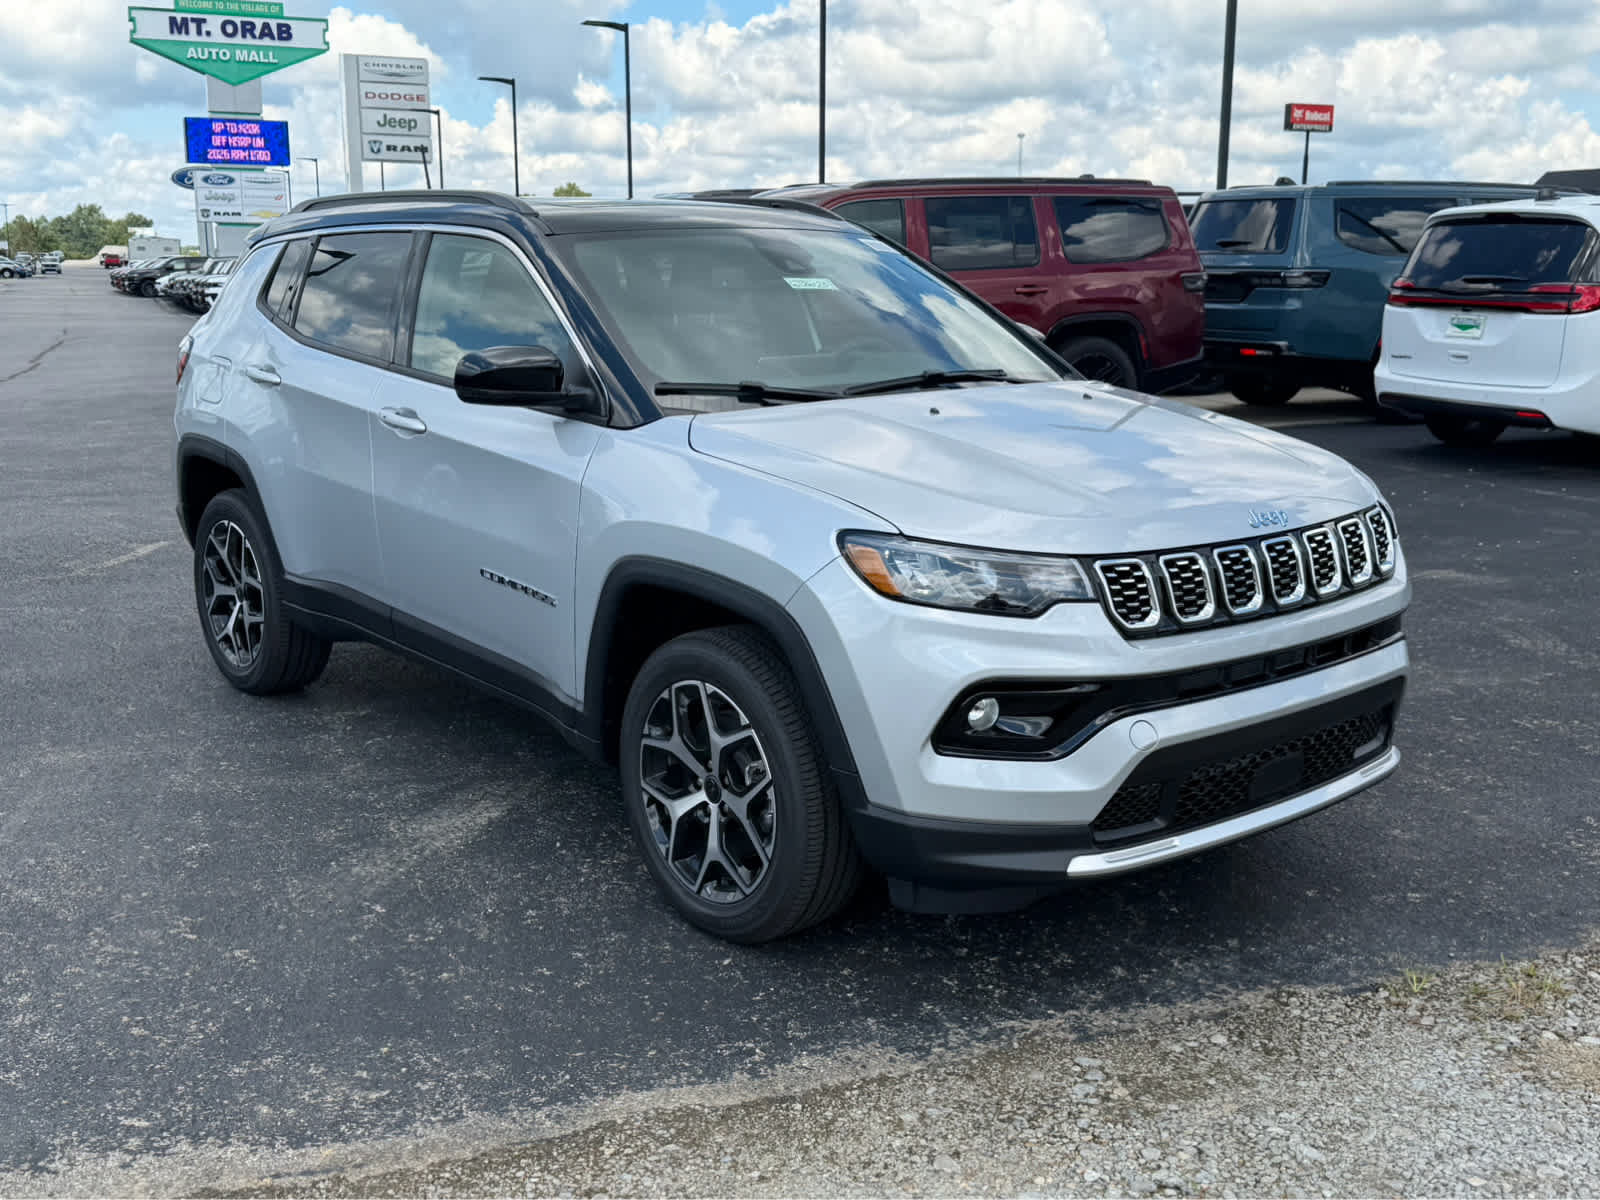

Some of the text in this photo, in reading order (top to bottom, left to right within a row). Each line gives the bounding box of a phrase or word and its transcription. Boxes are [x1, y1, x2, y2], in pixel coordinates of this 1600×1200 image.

[178, 0, 213, 9] WELCOME
[215, 1, 224, 9] TO
[226, 2, 240, 10] THE
[240, 3, 269, 12] VILLAGE
[168, 16, 293, 41] MT. ORAB
[187, 47, 279, 64] AUTO MALL
[364, 62, 423, 70] CHRYSLER
[365, 91, 426, 102] DODGE
[212, 121, 224, 133] UP
[226, 122, 237, 134] TO
[376, 113, 417, 131] Jeep
[212, 135, 227, 147] OFF
[207, 149, 230, 160] 2026
[231, 149, 249, 160] RAM
[386, 144, 428, 153] RAM
[207, 174, 230, 185] Ford
[1248, 509, 1288, 528] Jeep
[480, 567, 558, 608] COMPASS
